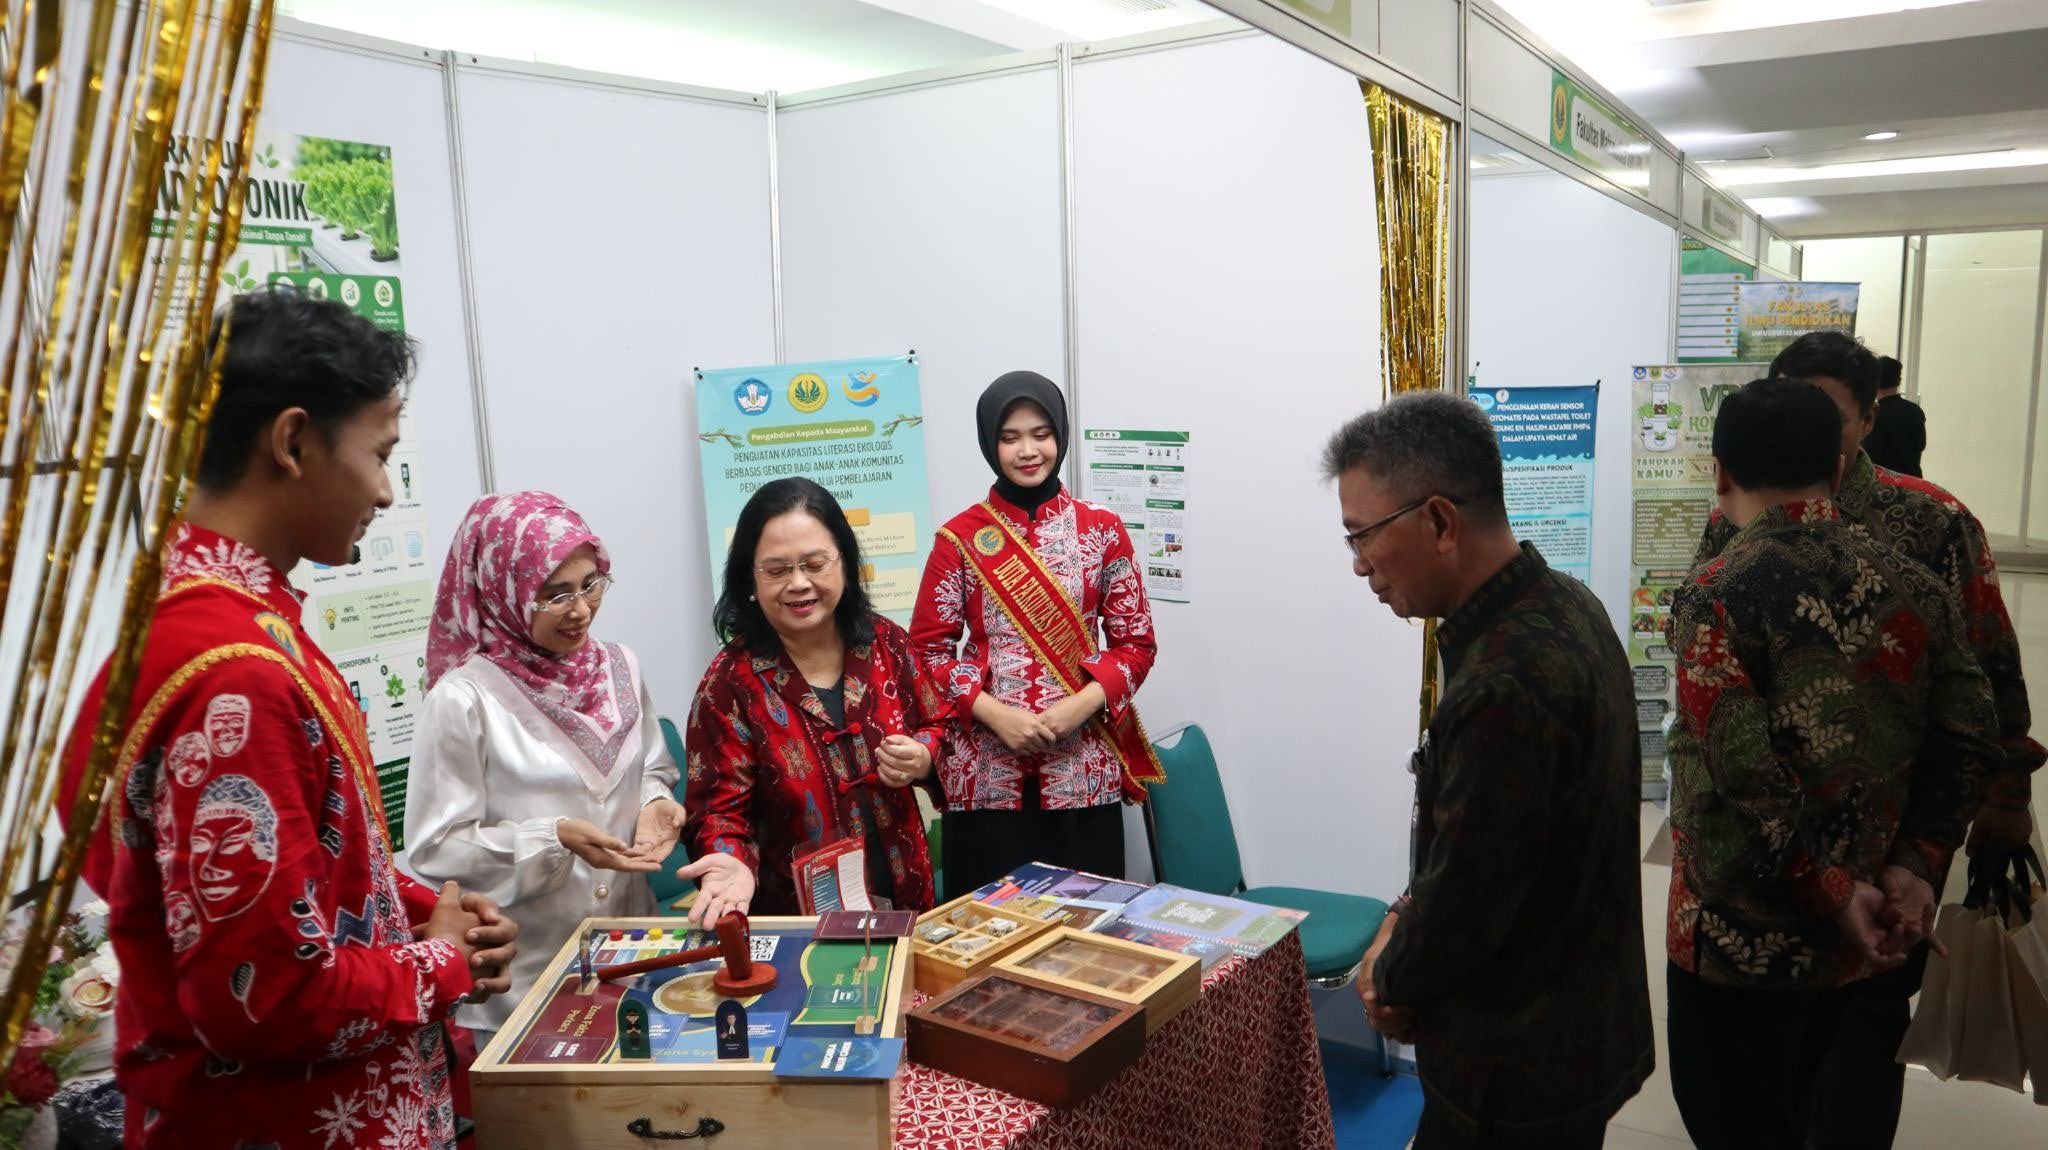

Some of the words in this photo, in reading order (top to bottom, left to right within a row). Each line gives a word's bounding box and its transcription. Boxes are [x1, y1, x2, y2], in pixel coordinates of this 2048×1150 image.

[1576, 112, 1599, 148] Fakultas
[1746, 314, 1777, 326] ILMU
[1779, 314, 1851, 326] PENDIDIKAN
[1497, 403, 1539, 411] PENGGUNAAN
[1539, 402, 1560, 410] KERAN
[1560, 402, 1585, 410] SENSOR
[1489, 413, 1522, 422] OTOMATIS
[1522, 413, 1540, 422] PADA
[1540, 413, 1571, 421] WASTAFEL
[1571, 412, 1592, 420] TOILET
[751, 430, 795, 441] Pengabdian
[796, 428, 824, 439] Kepada
[825, 425, 869, 435] Masyarakat
[1493, 424, 1514, 432] EDUNG
[1573, 423, 1591, 431] FMIPA
[1502, 435, 1526, 443] DALAM
[1525, 434, 1546, 442] UPAYA
[1567, 433, 1578, 441] AIR
[734, 450, 780, 463] PENGUATAN
[782, 446, 823, 459] KAPASITAS
[824, 443, 856, 456] LITERASI
[857, 440, 893, 453] EKOLOGIS
[725, 466, 762, 479] BERBASIS
[763, 463, 793, 476] GENDER
[794, 462, 812, 474] BAGI
[813, 458, 860, 471] ANAK-ANAK
[861, 455, 904, 468] KOMUNITAS
[1637, 469, 1673, 479] KAMU
[835, 471, 892, 485] PEMBELAJARAN
[993, 553, 1030, 592] DUTA
[1010, 576, 1062, 633] FAKULTAS
[1041, 616, 1077, 656] ILMU
